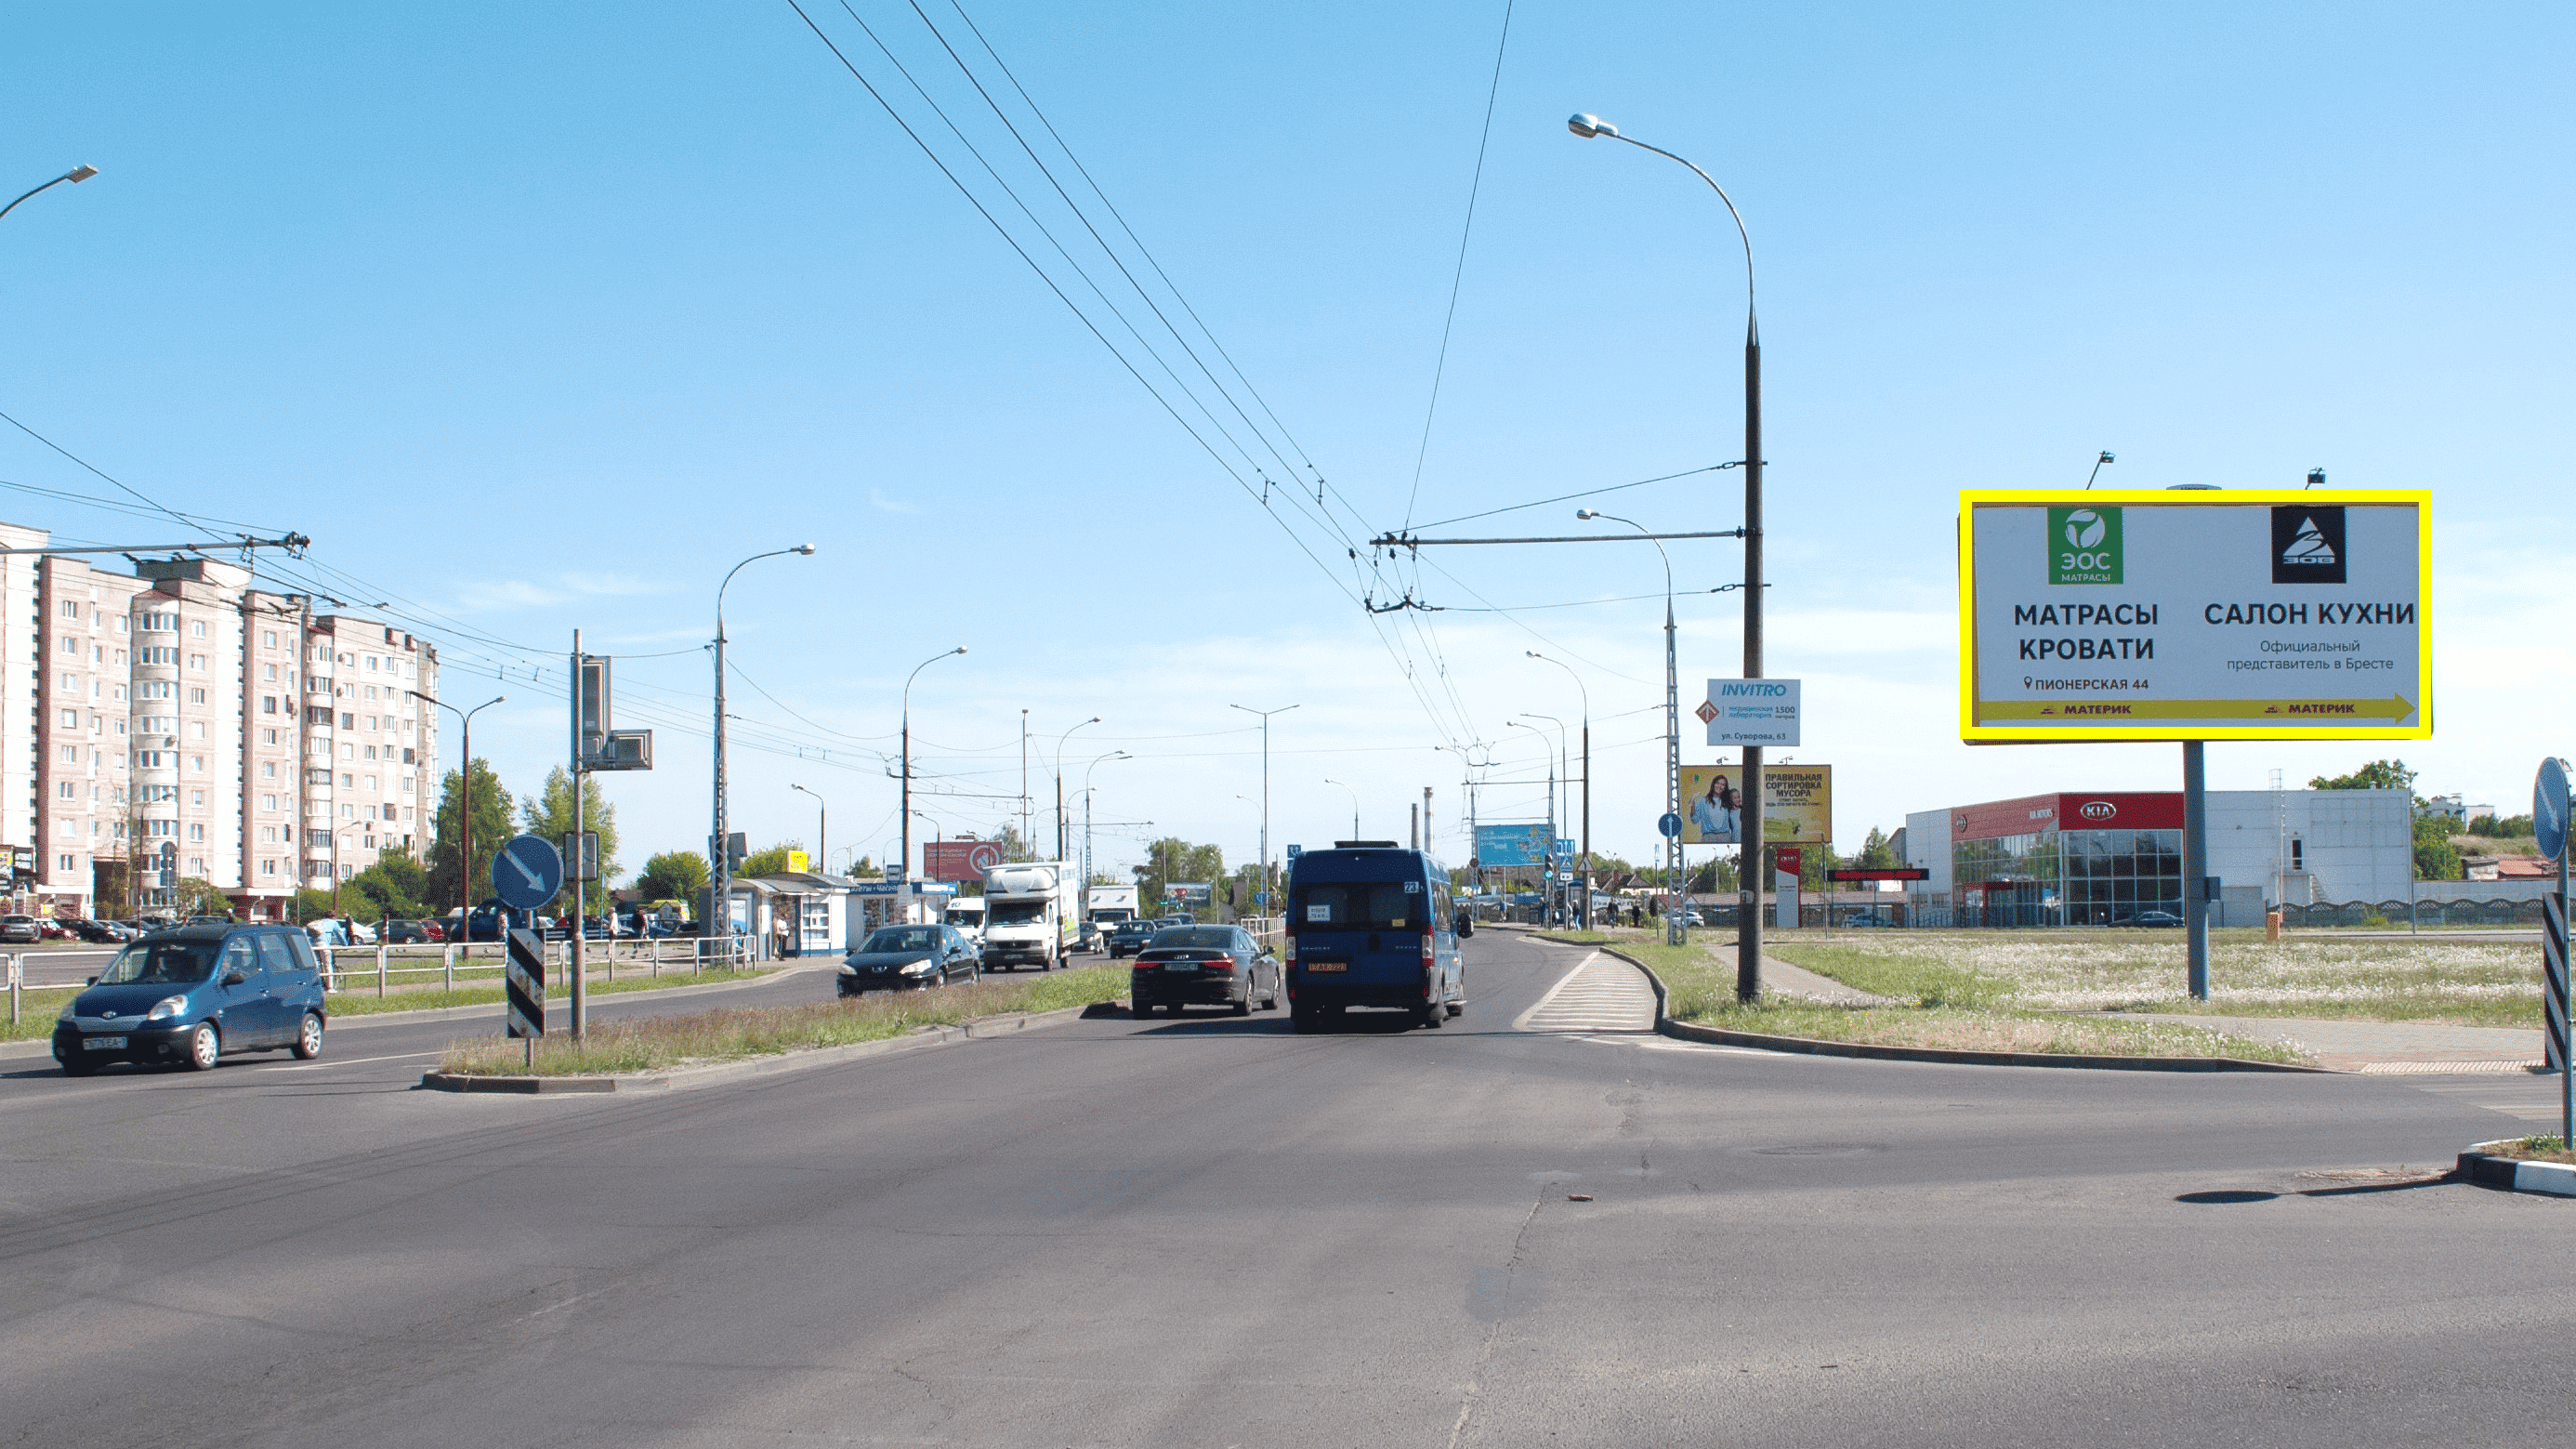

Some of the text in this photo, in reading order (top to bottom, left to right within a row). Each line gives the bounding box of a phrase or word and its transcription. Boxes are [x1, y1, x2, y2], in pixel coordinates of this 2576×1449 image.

[2061, 552, 2111, 570] ЭОС
[2061, 573, 2111, 582] МАТРАСЫ
[2015, 604, 2158, 626] МАТРАСЫ
[2204, 603, 2415, 625] САЛОН КУХНИ
[2019, 639, 2154, 660] КРОВАТИ
[2260, 640, 2360, 654] Официальный
[2228, 658, 2394, 672] представитель в Бресте
[1721, 684, 1787, 696] INVITRO
[2035, 679, 2149, 690] ПИОНЕРСКАЯ 44
[2064, 705, 2132, 715] МАТЕРИК
[2289, 704, 2356, 714] МАТЕРИК
[1734, 732, 1775, 741] Суворова,
[1766, 773, 1822, 782] ПРАВИЛЬНАЯ
[1766, 782, 1822, 790] СОРТИРОВКА
[2086, 806, 2110, 817] KIA
[1405, 883, 1416, 893] 23
